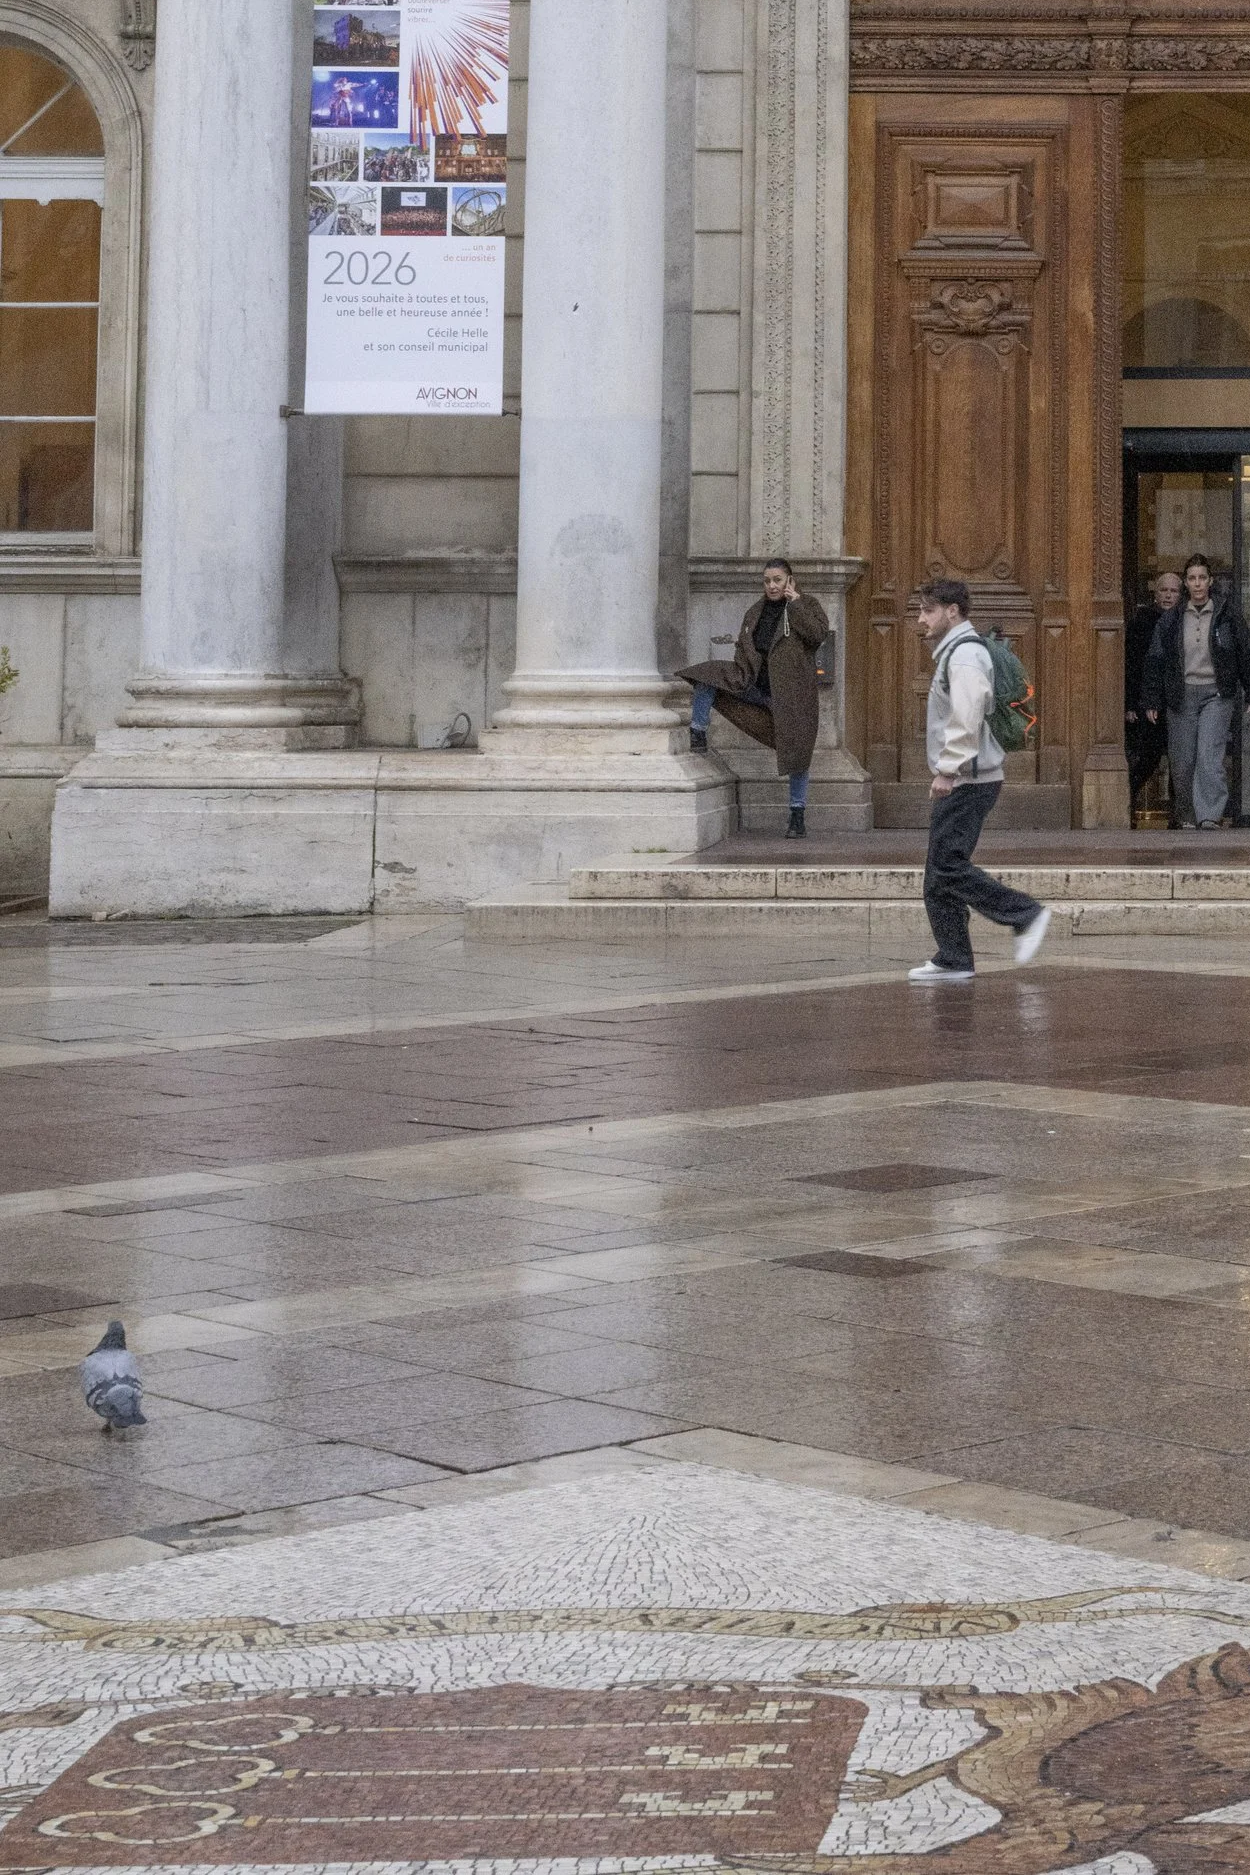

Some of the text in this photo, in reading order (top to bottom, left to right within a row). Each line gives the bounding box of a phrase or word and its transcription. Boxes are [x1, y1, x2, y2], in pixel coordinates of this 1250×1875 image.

[443, 253, 496, 262] de curiosités
[323, 250, 417, 286] 2026
[322, 293, 333, 303] Je
[361, 293, 404, 303] souhaite
[407, 293, 413, 303] à
[416, 295, 448, 303] toutes
[451, 295, 461, 303] et
[464, 295, 489, 305] tous,
[336, 309, 356, 317] une
[358, 307, 383, 317] belle
[386, 309, 396, 317] et
[400, 307, 448, 317] heureuse
[451, 307, 482, 317] année
[427, 327, 489, 338] Cécile Helle
[363, 343, 374, 351] et
[398, 342, 435, 352] conseil
[437, 342, 489, 354] municipal
[415, 387, 478, 400] AVIGNON
